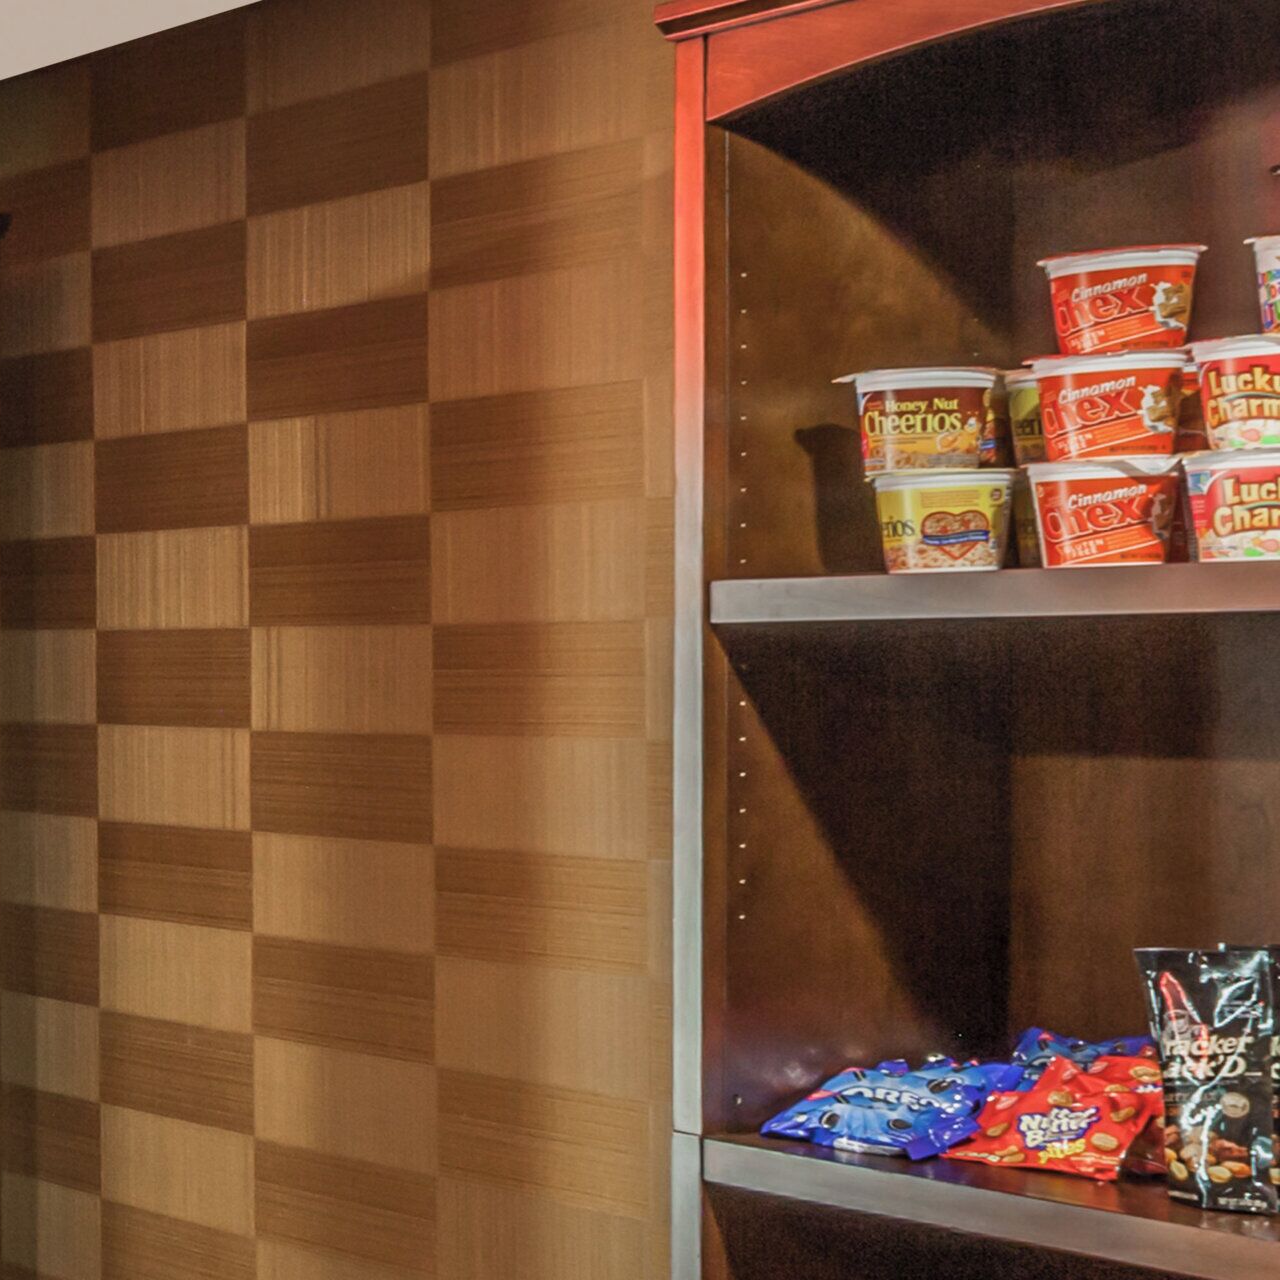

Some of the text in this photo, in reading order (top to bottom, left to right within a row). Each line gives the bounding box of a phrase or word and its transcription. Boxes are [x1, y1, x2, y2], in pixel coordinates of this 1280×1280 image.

[1072, 273, 1148, 302] Cinnamon
[1058, 376, 1136, 404] Cinnamon
[887, 398, 958, 413] Honey Nut
[1206, 398, 1280, 429] Charm
[864, 411, 962, 436] Cheerios
[1067, 484, 1148, 510] Cinnamon
[1164, 1034, 1255, 1056] racker
[1163, 1055, 1247, 1079] ack'D
